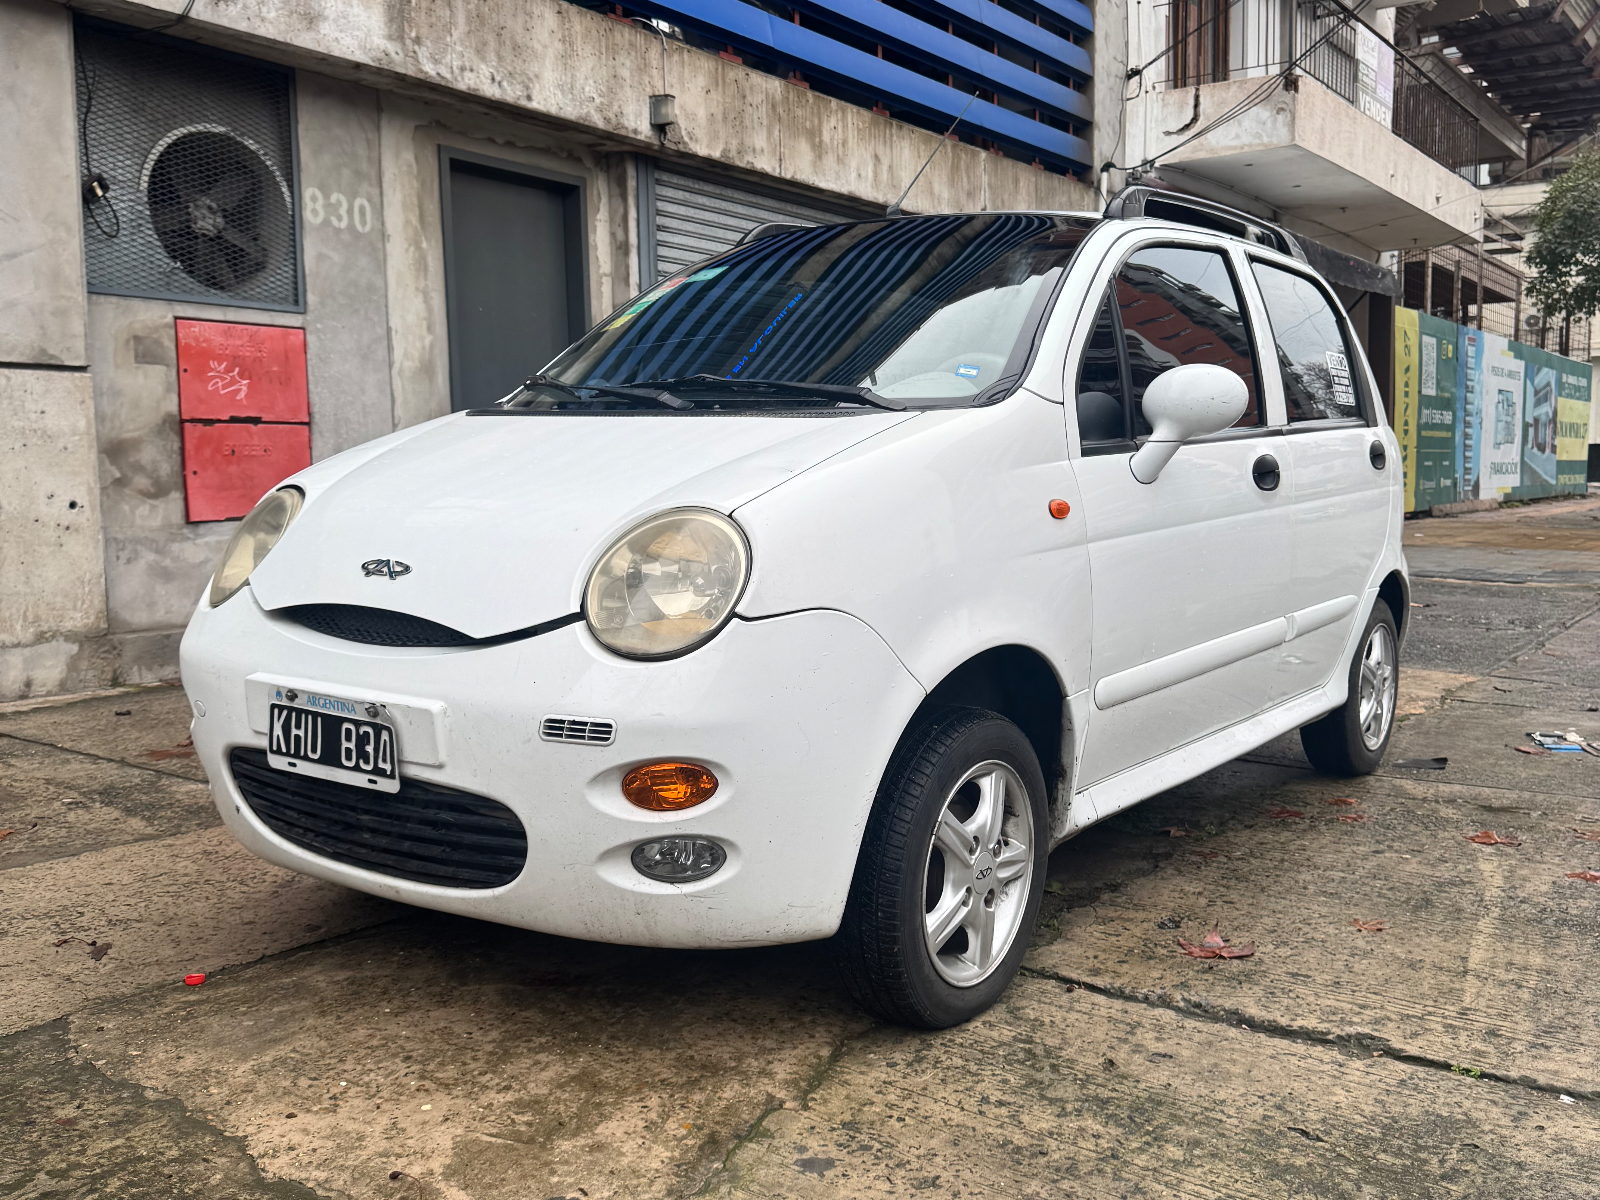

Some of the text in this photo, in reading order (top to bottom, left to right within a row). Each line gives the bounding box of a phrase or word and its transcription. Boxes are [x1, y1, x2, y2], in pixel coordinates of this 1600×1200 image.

[1359, 91, 1391, 130] VENDEN
[304, 187, 372, 233] 830
[1403, 329, 1411, 357] 27
[306, 694, 357, 715] ARGENTINA
[272, 707, 392, 775] KHU 834
